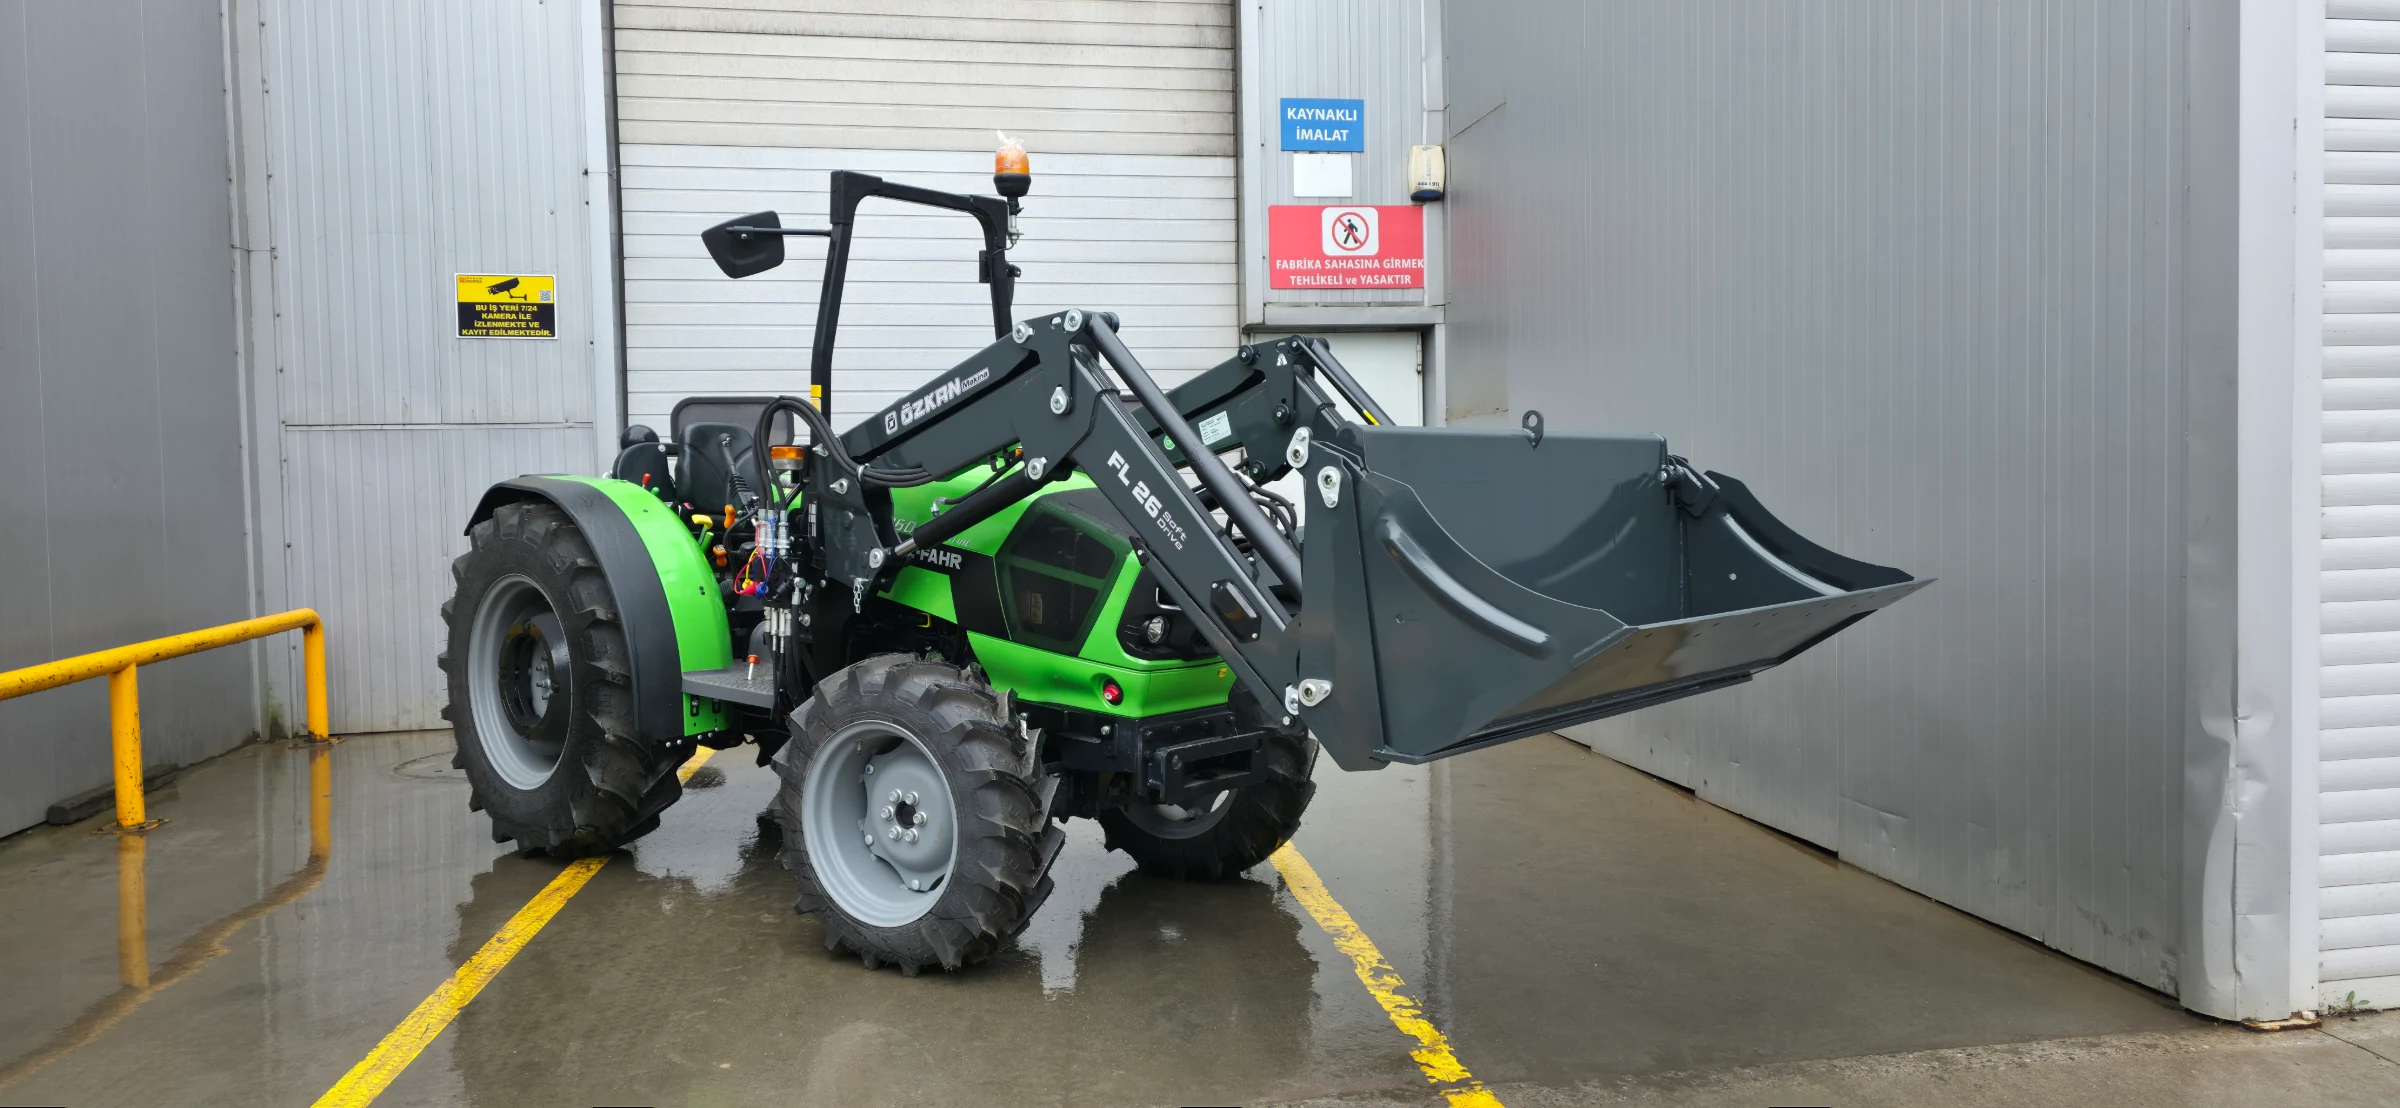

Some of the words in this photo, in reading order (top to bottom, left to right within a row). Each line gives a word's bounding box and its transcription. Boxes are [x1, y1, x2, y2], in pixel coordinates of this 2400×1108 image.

[1287, 107, 1357, 121] KAYNAKLI
[1296, 125, 1349, 141] İMALAT
[1276, 258, 1322, 269] FABRİKA
[1325, 259, 1380, 269] SAHASINA
[1383, 257, 1424, 269] GİRMEK
[1290, 273, 1343, 285] TEHLİKELİ
[1345, 276, 1357, 285] ve
[1360, 275, 1412, 285] YASAKTIR
[489, 304, 497, 312] İŞ
[474, 320, 527, 328] İZLENMEKTE
[489, 328, 552, 336] EDİLMEKTEDİR.
[901, 377, 962, 426] ÖZKAN
[962, 369, 989, 391] Makina
[1107, 449, 1130, 487] FL
[1132, 480, 1163, 518] 26
[1162, 511, 1187, 542] Soft
[894, 518, 918, 533] 60
[1156, 517, 1183, 551] Drive
[908, 548, 963, 570] -FAHR
